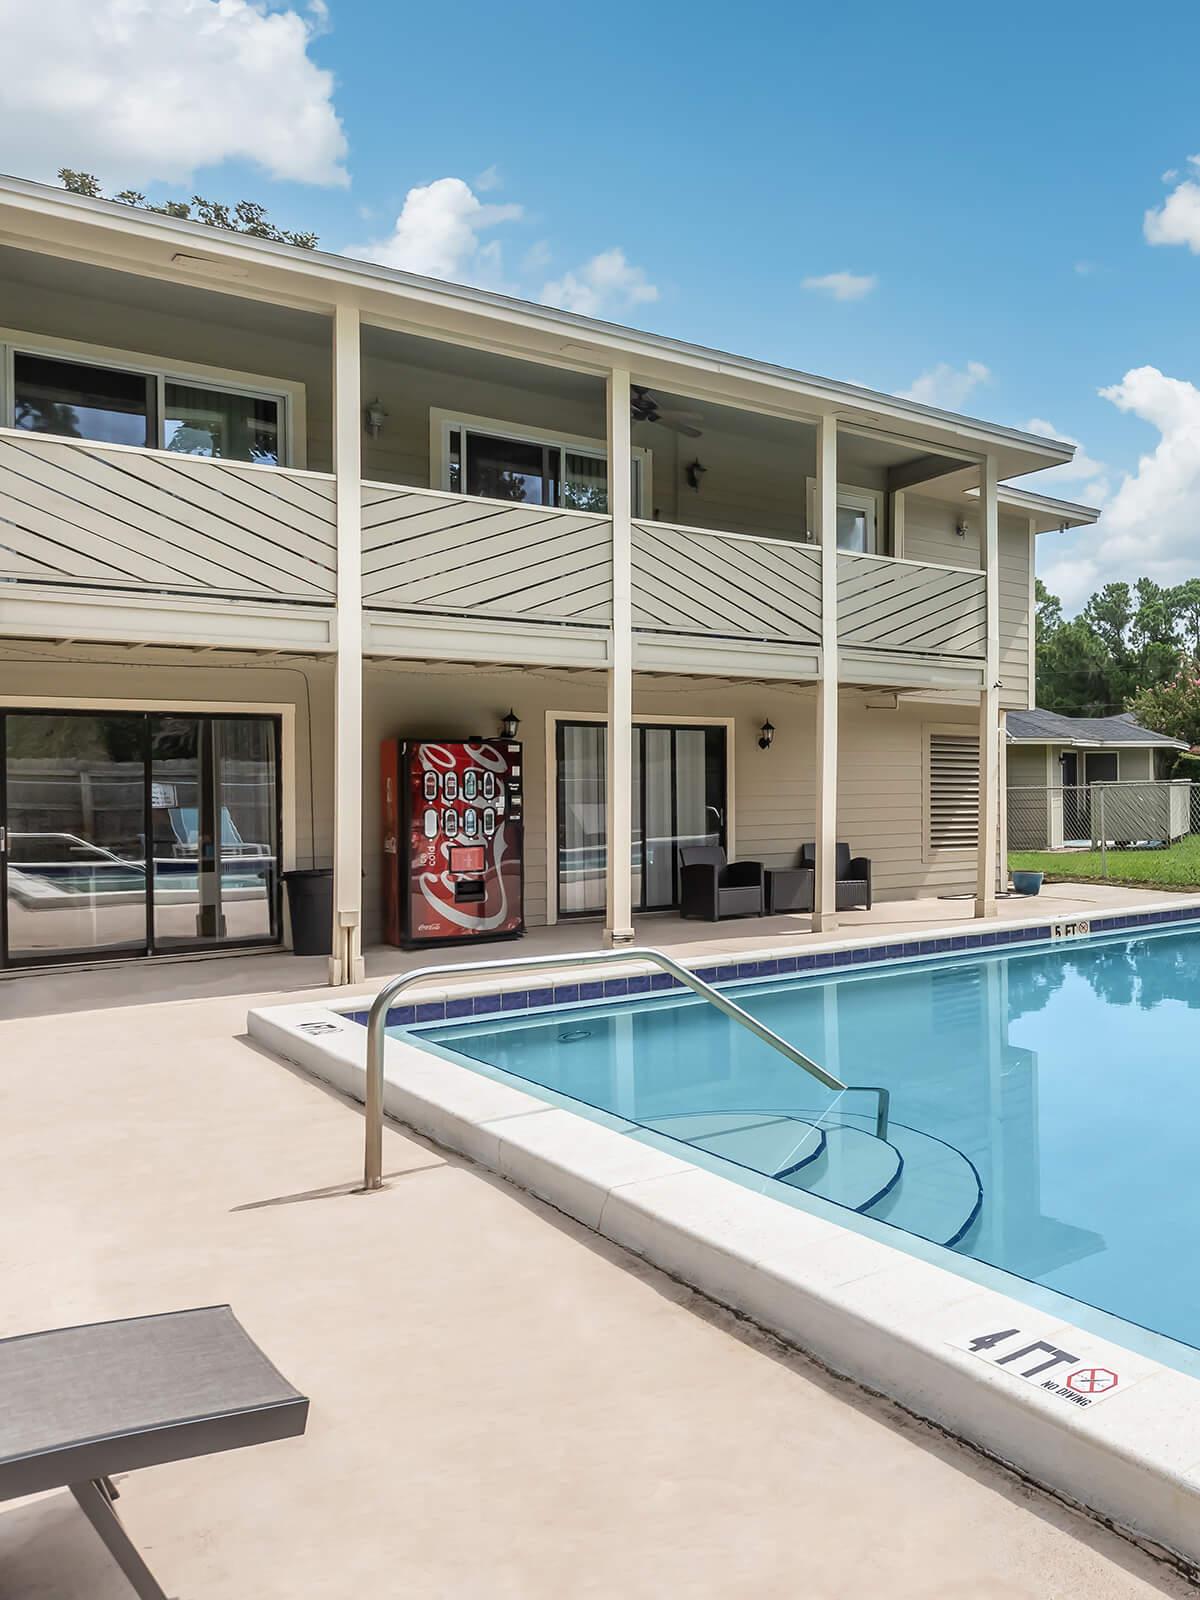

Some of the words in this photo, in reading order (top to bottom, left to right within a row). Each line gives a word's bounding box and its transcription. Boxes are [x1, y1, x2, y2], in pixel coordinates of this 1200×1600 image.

[427, 846, 436, 866] cold
[1065, 923, 1077, 936] FT
[968, 1329, 1021, 1352] 4
[1040, 1380, 1060, 1391] NO
[1055, 1387, 1092, 1407] DIVING
